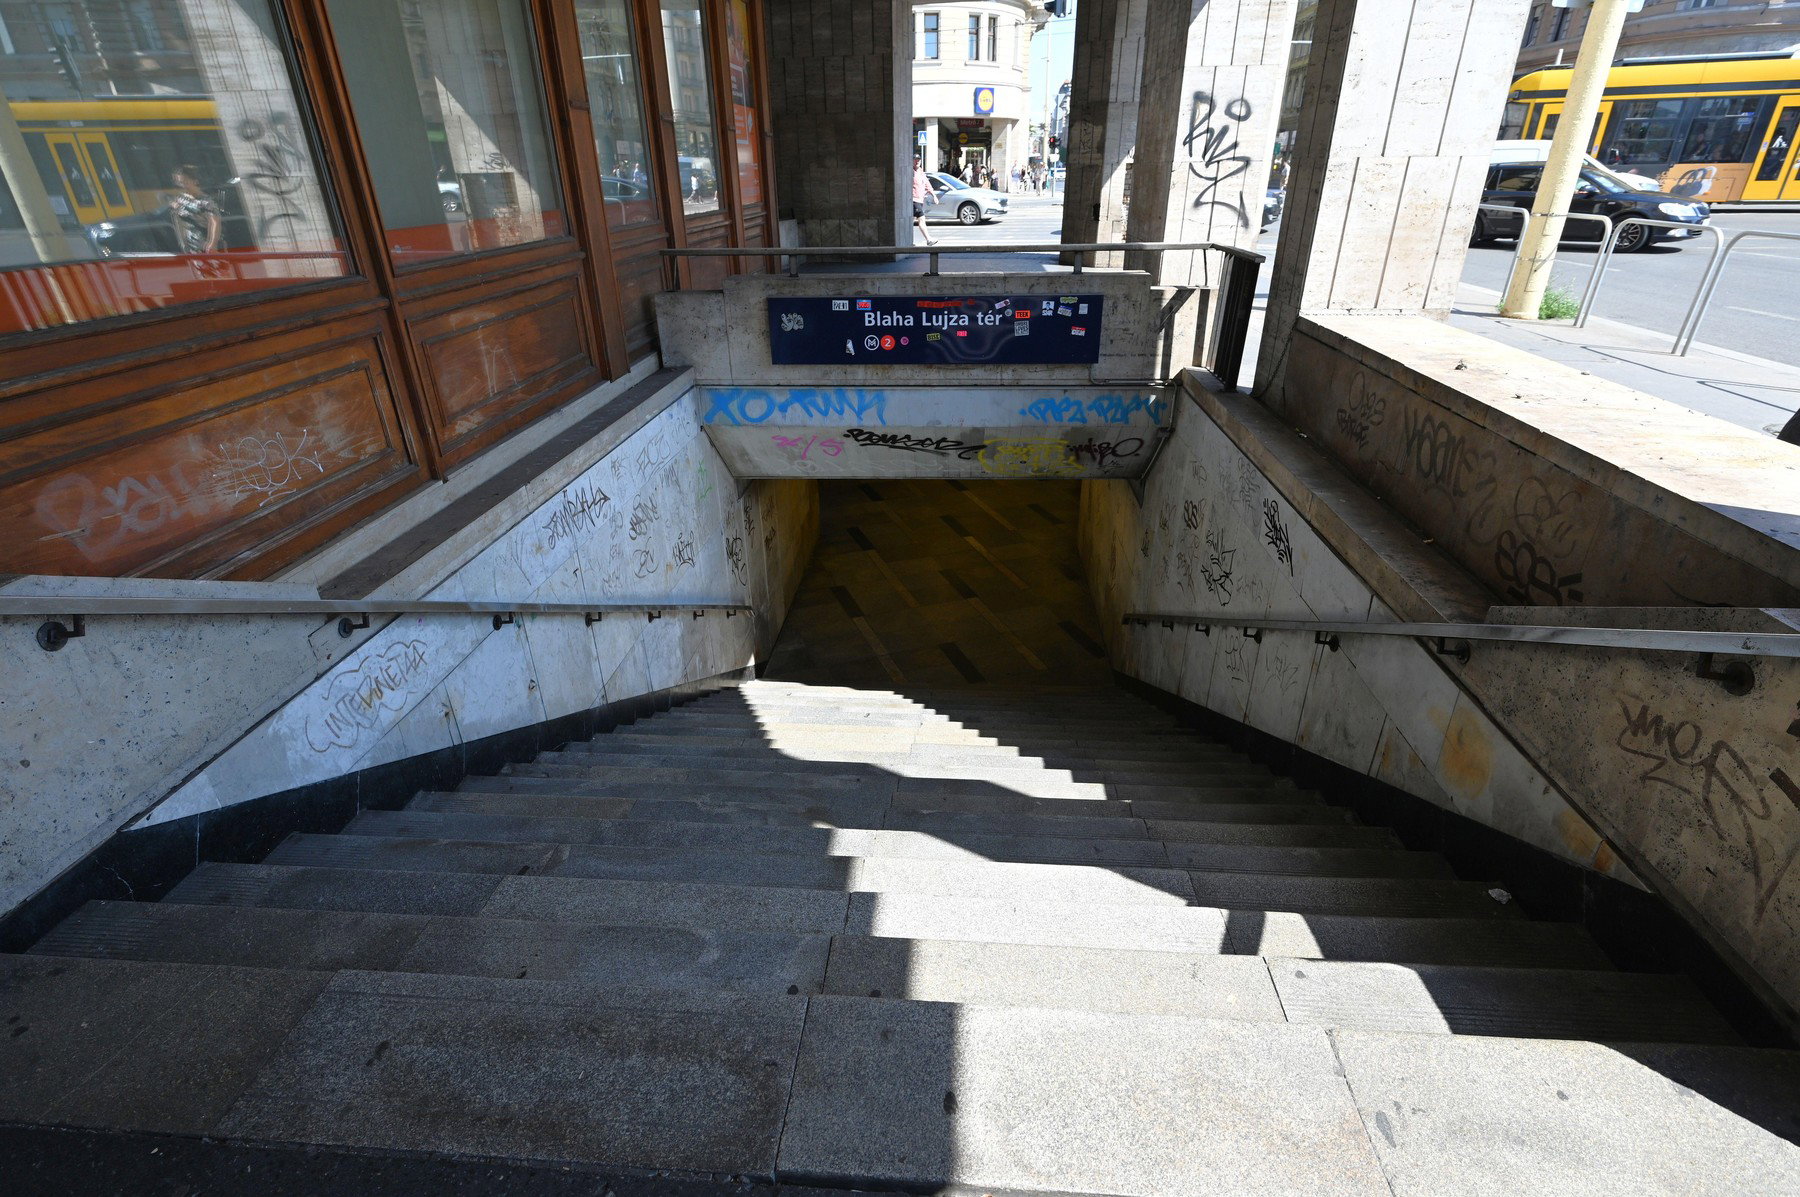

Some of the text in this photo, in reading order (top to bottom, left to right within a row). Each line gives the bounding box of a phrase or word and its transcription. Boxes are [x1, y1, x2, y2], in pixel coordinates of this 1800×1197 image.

[864, 310, 1002, 330] Blaha Lujza tér
